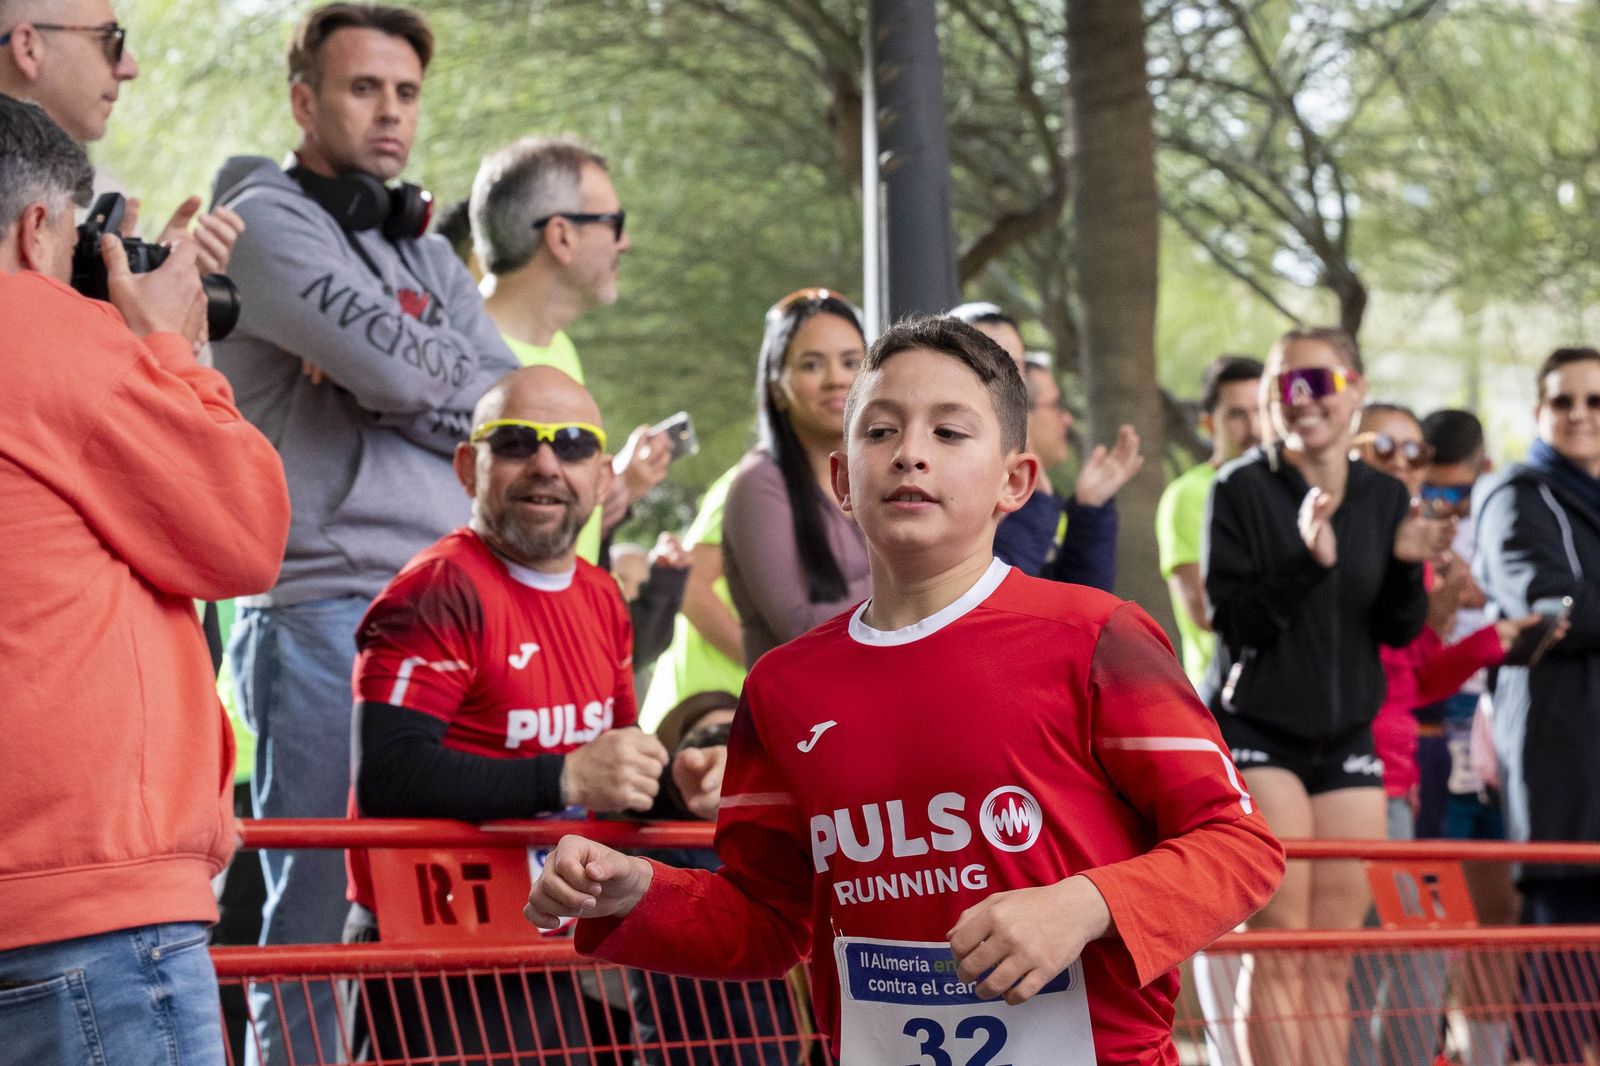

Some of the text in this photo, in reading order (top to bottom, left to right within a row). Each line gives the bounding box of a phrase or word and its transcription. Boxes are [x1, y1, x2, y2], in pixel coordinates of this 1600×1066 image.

[414, 863, 492, 925] RT
[833, 864, 988, 905] RUNNING
[871, 953, 930, 973] Almería
[933, 960, 958, 973] en
[868, 978, 917, 995] contra
[921, 979, 939, 996] el
[902, 1015, 1012, 1066] 32
